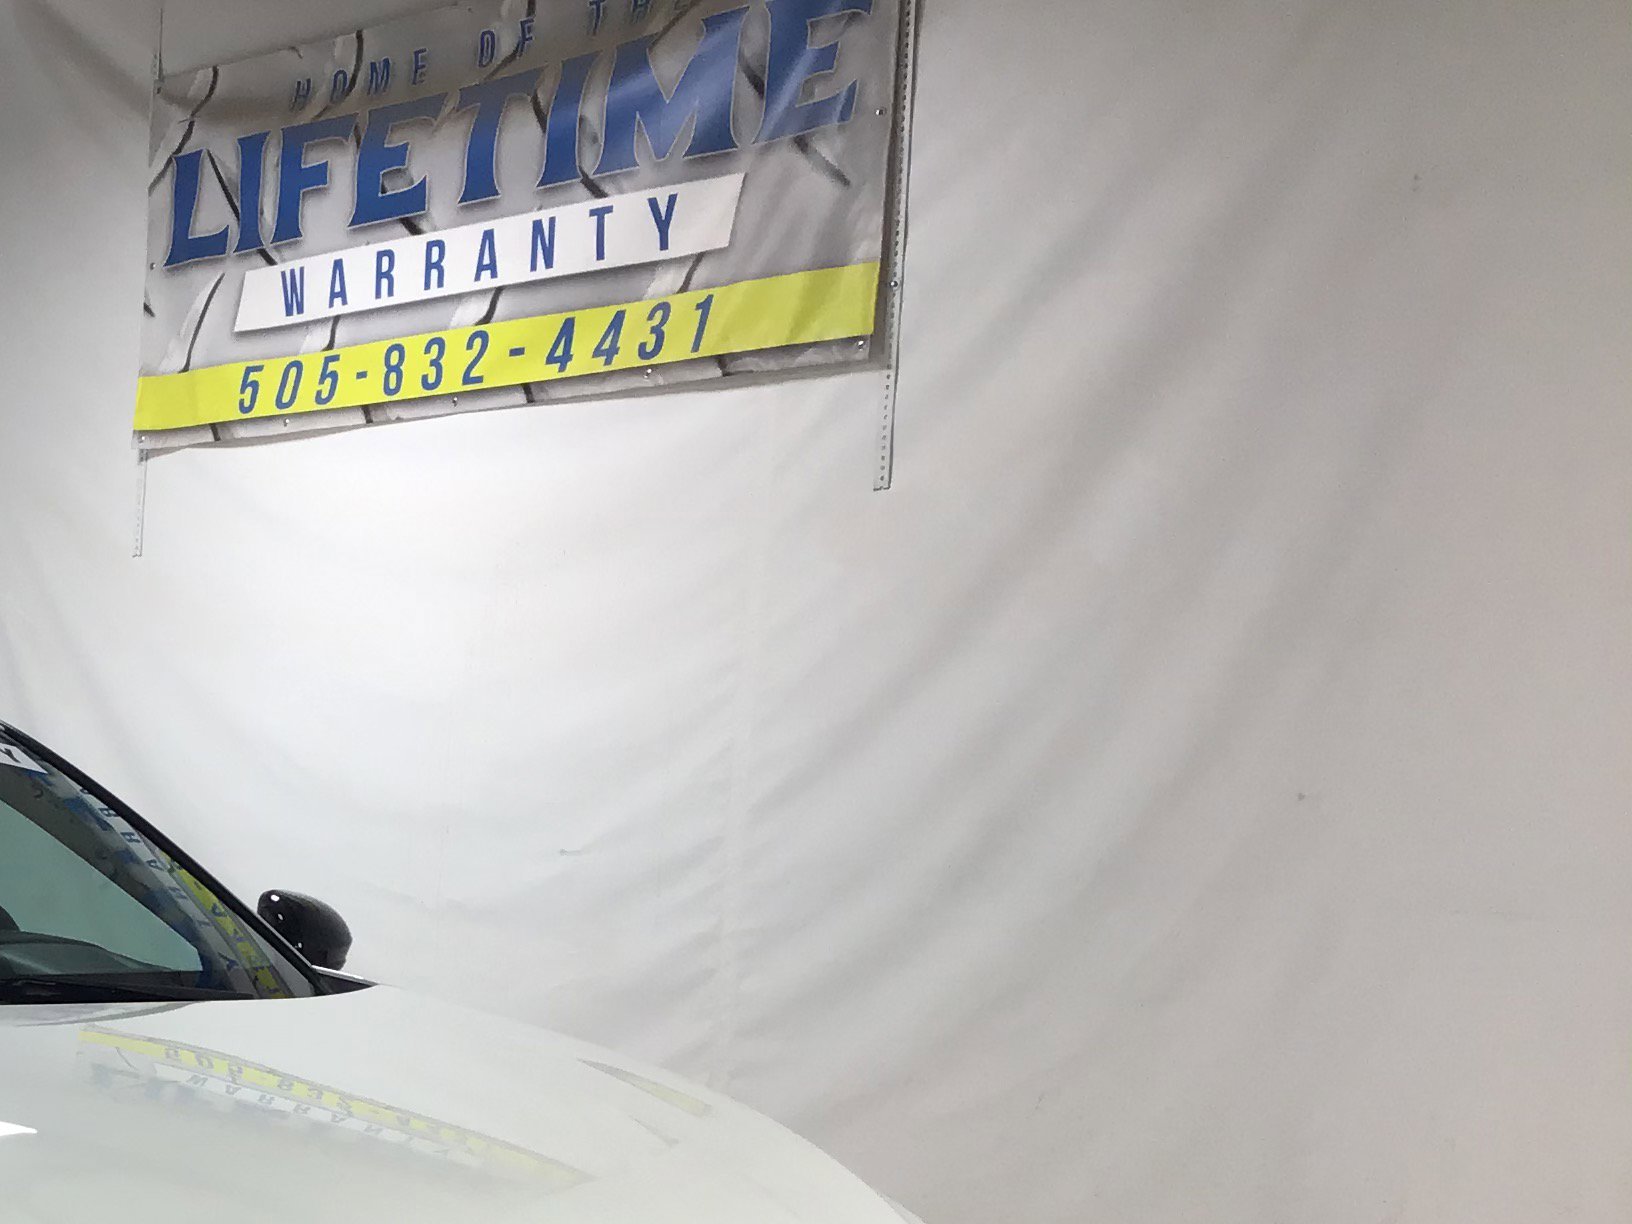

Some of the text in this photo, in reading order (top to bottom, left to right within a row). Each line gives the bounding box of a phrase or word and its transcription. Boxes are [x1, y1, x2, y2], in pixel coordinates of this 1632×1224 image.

[292, 0, 693, 111] HOME OF TH
[164, 0, 873, 268] LIFETIME
[281, 193, 681, 318] WARRANTY
[237, 294, 715, 416] 505-832-4431
